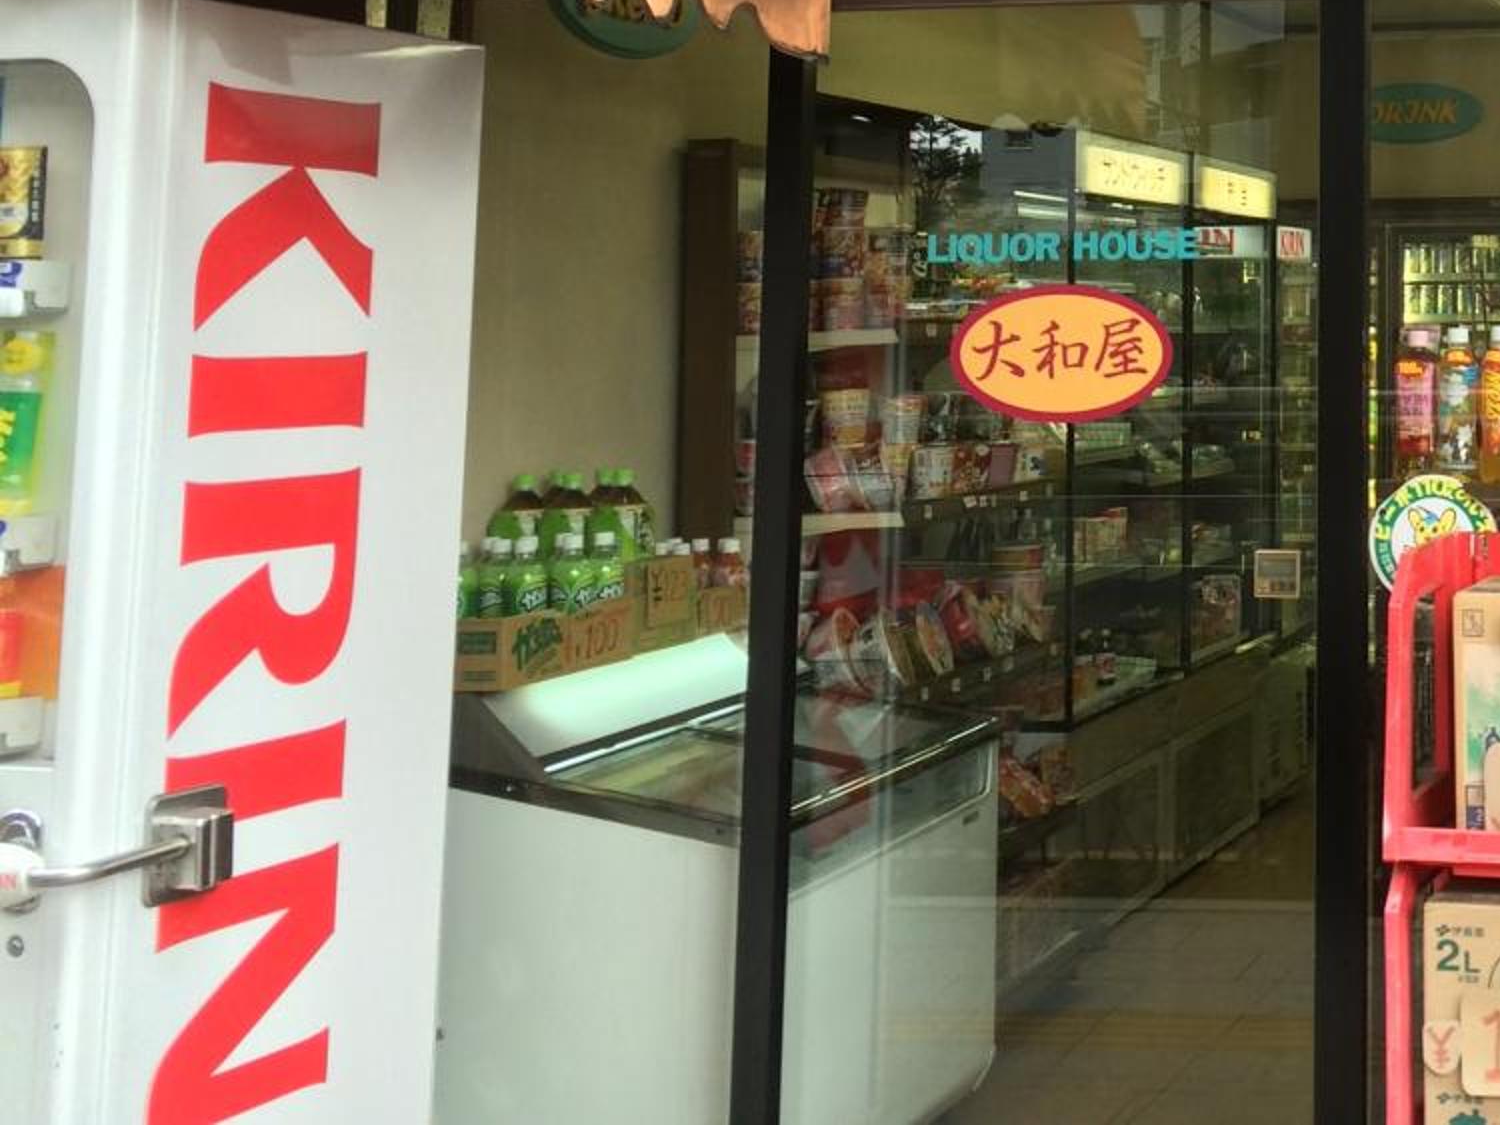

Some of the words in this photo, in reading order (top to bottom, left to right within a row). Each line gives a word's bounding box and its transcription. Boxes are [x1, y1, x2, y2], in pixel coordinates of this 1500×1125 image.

[925, 231, 1062, 267] LIQUOR
[1073, 227, 1201, 262] HOUSE
[970, 317, 1150, 381] 大和屋
[144, 81, 382, 1125] KIRIN
[1436, 939, 1480, 973] 2L
[1428, 1026, 1456, 1069] ¥
